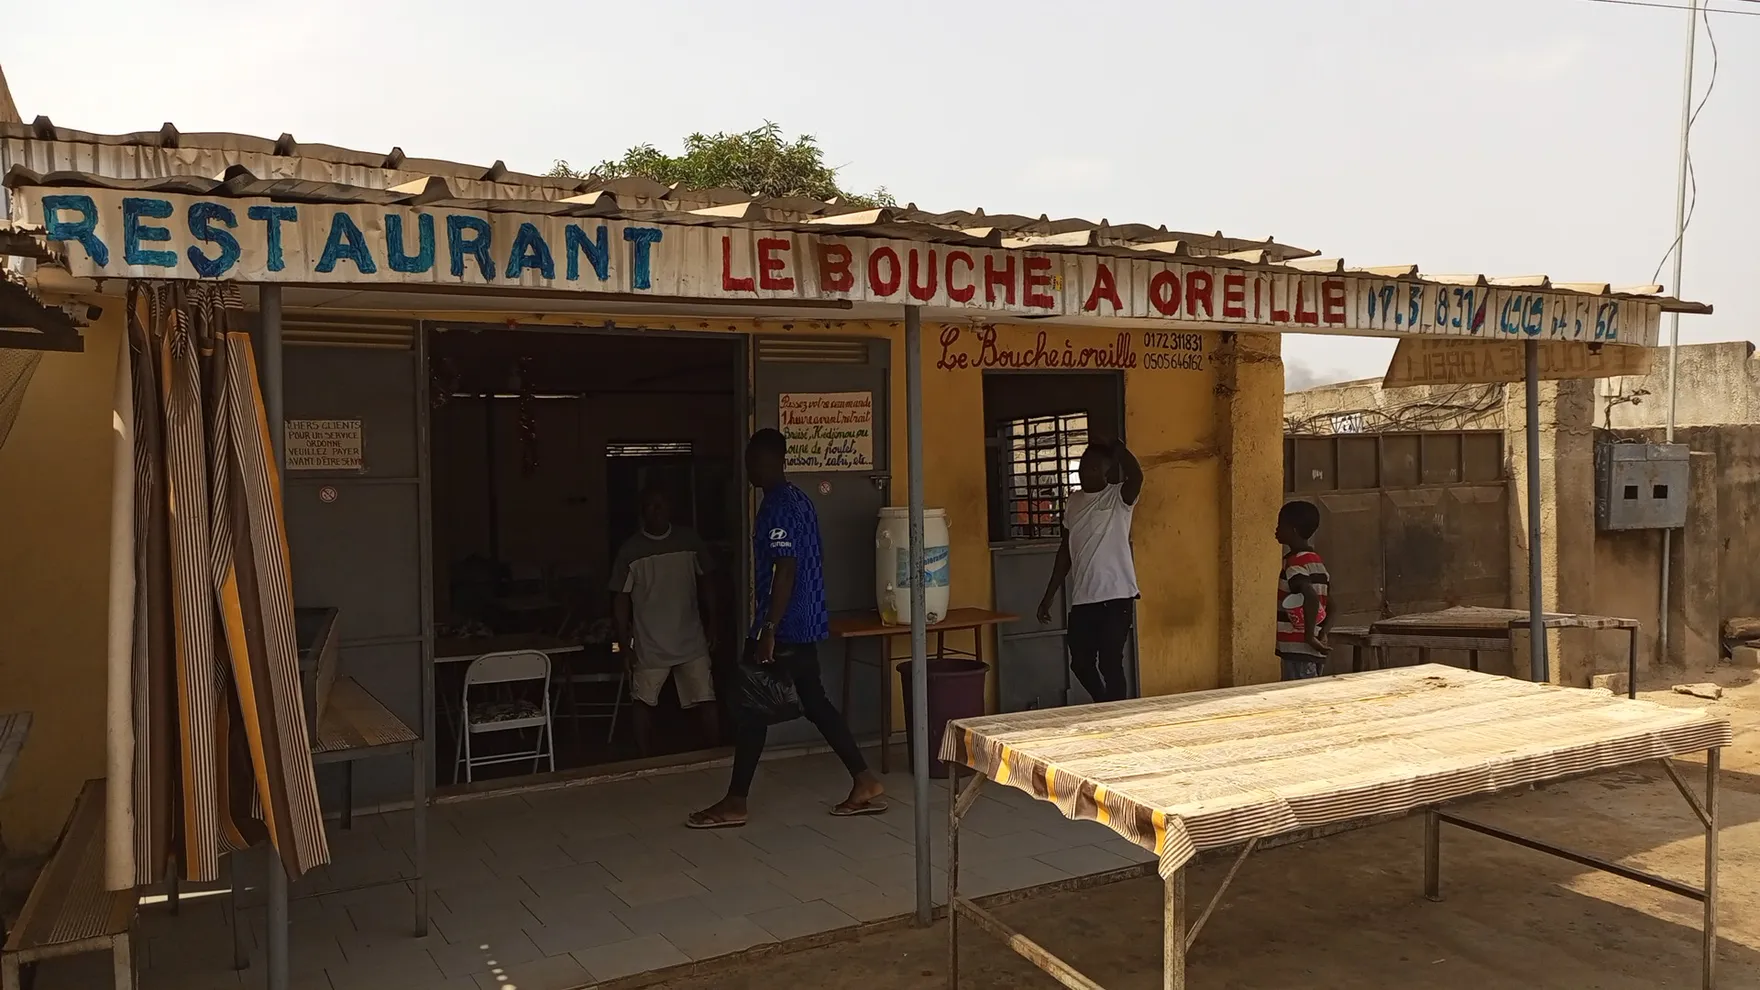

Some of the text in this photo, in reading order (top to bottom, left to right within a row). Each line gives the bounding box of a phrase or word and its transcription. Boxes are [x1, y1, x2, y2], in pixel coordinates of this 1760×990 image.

[42, 195, 662, 290] RESTAURANT
[722, 236, 794, 293] LE
[818, 243, 1054, 308] BOUCHE
[1084, 263, 1123, 312] A
[1150, 269, 1346, 326] OREILLE
[937, 324, 968, 371] Le
[972, 323, 1059, 367] Bouche
[1143, 332, 1203, 351] 0172311831
[1143, 353, 1203, 371] 0505646162
[322, 421, 361, 429] CLIENTS
[288, 431, 311, 439] POUR
[288, 447, 359, 455] VEUILLEZ PAYER
[811, 441, 821, 454] de
